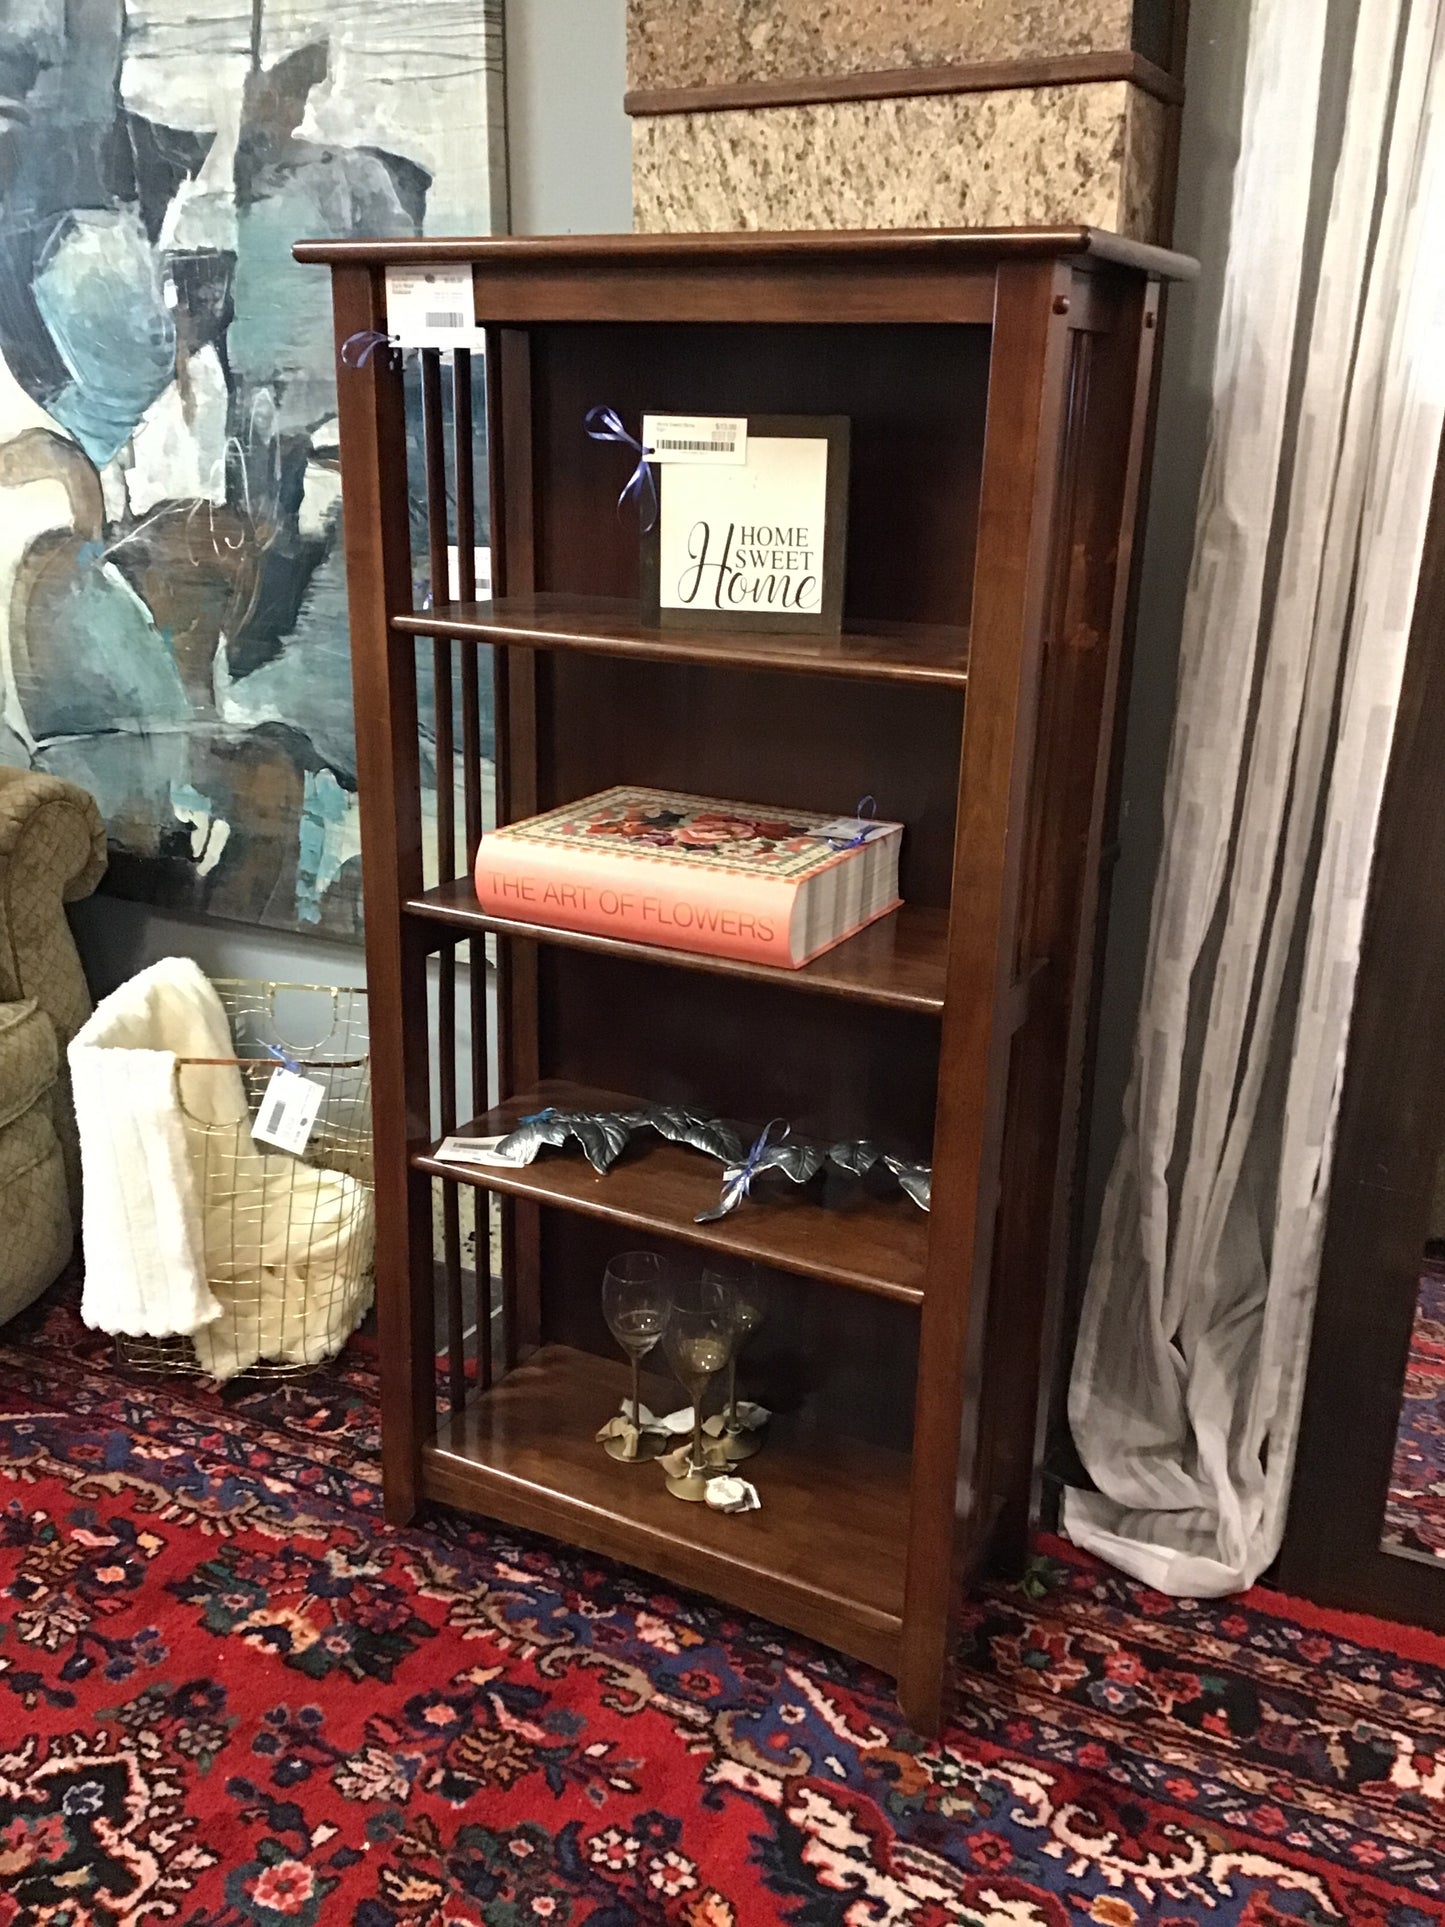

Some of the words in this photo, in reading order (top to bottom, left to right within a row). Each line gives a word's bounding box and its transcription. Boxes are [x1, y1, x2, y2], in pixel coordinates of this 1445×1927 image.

[741, 525, 809, 547] HOME
[677, 520, 820, 609] Home
[735, 549, 814, 571] SWEET
[487, 872, 536, 901] THE
[543, 883, 592, 912] ART
[599, 889, 636, 918] OF
[642, 898, 774, 942] FLOWERS
